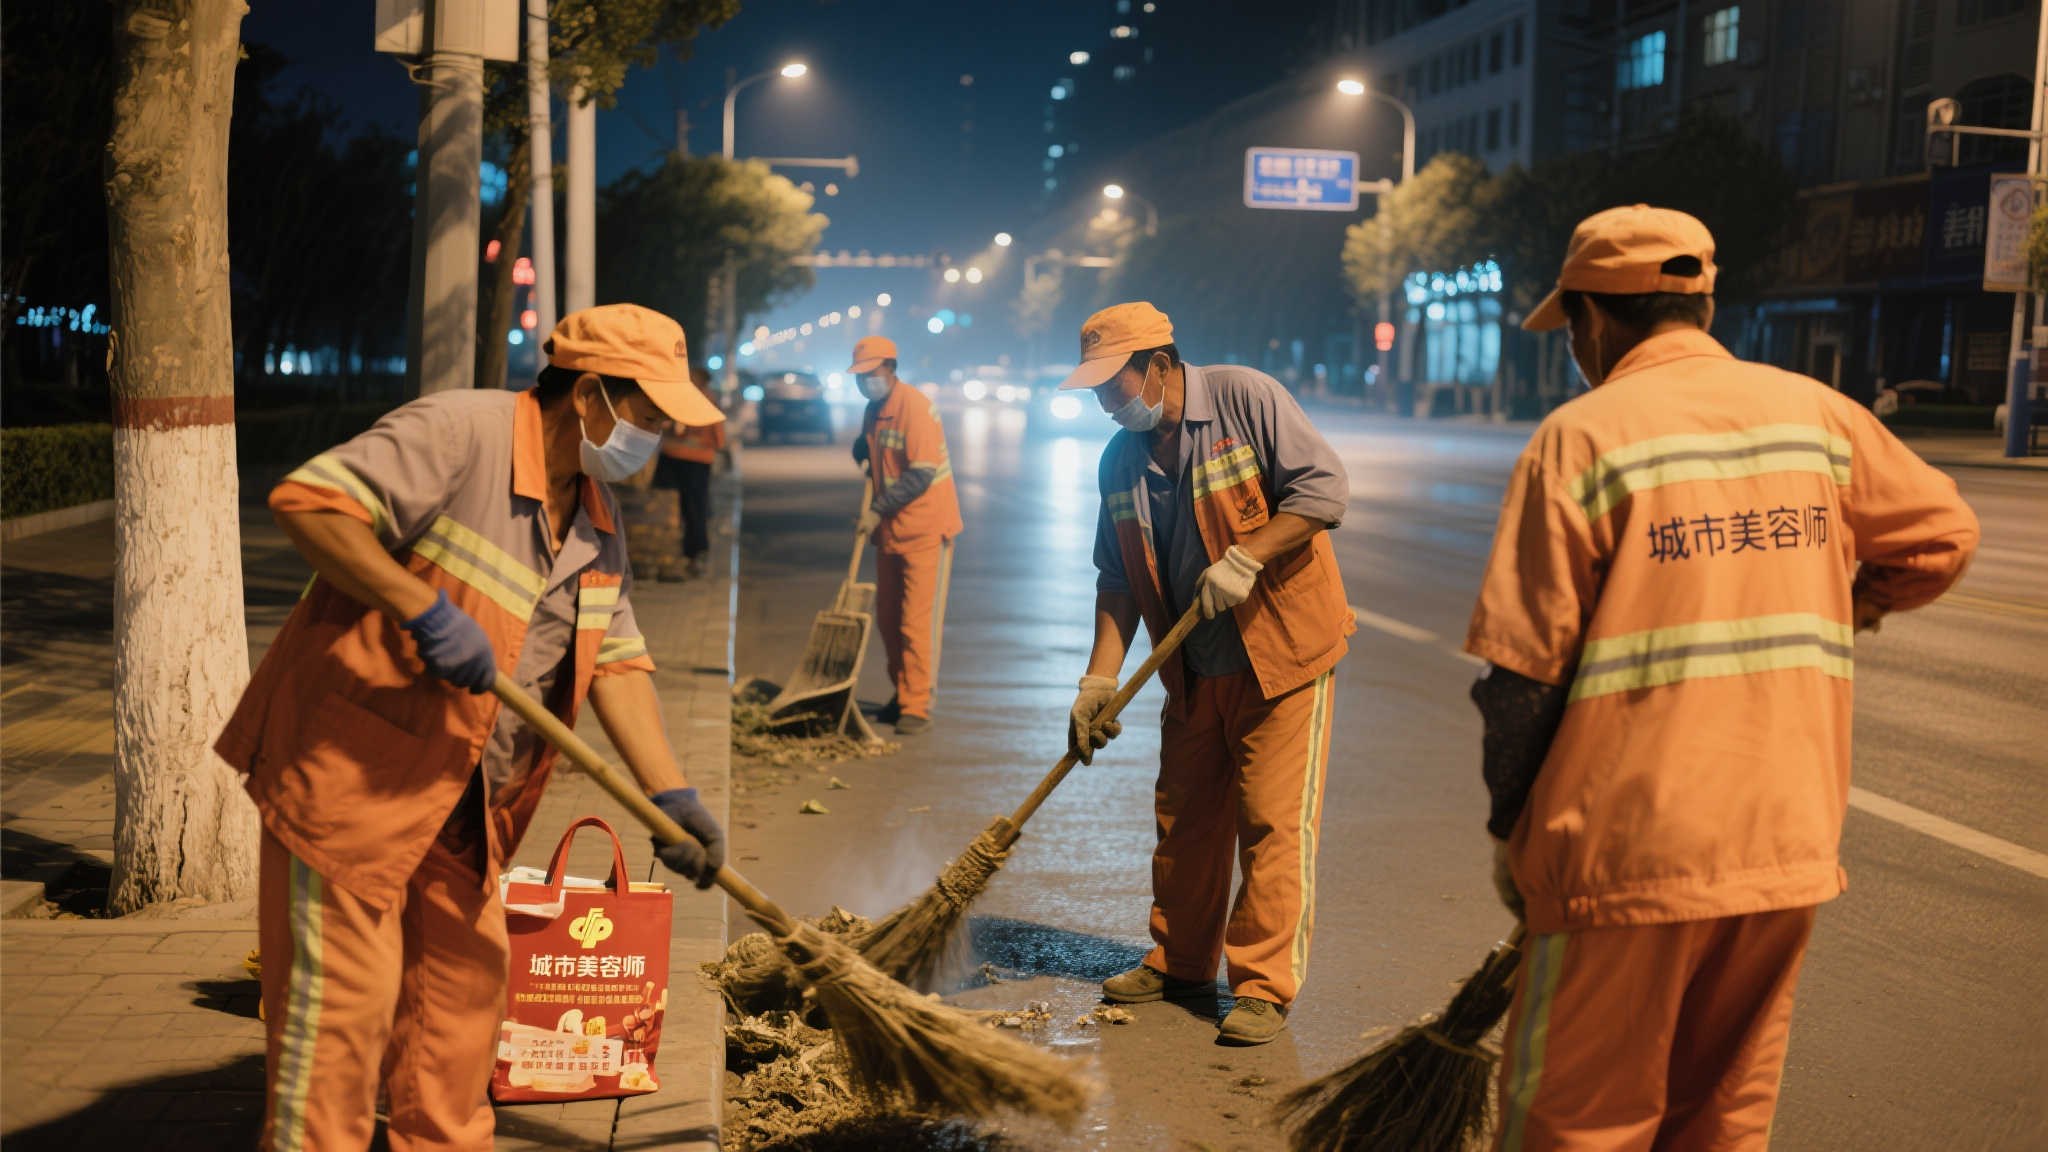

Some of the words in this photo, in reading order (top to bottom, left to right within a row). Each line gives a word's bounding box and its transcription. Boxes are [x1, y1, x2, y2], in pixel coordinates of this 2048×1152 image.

[1648, 504, 1828, 564] 城市美容师
[529, 953, 646, 978] 城市美容师
